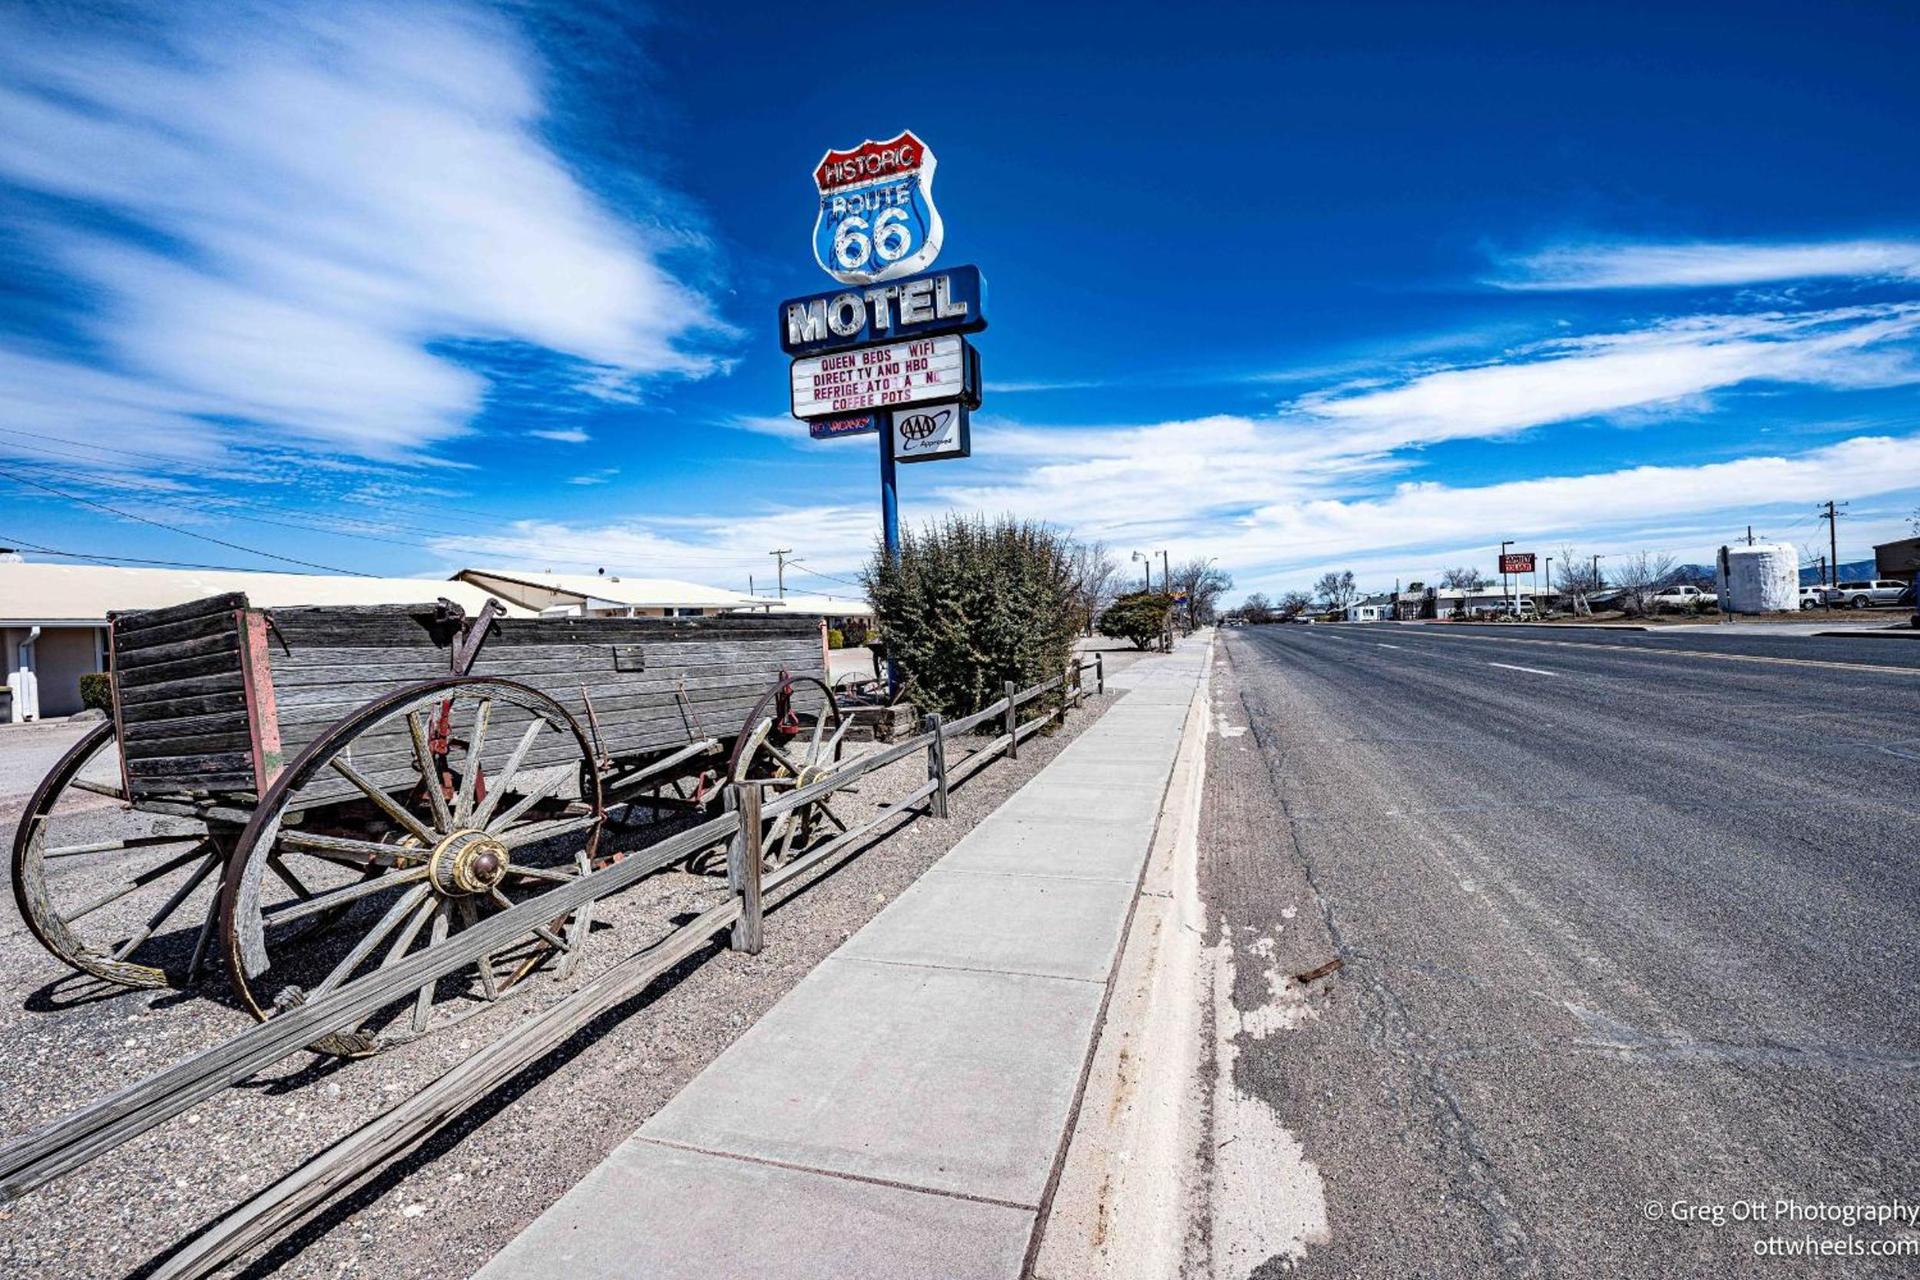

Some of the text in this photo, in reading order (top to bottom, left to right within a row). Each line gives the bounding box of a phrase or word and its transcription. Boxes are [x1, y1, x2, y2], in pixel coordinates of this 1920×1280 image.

[824, 145, 914, 185] HISTORIC
[832, 182, 911, 216] ROUTE
[836, 207, 912, 268] 66
[788, 275, 967, 345] MOTEL
[813, 357, 928, 387] DIRECT TV AND HBO
[821, 341, 935, 372] QUEEN BEDS WIFI
[832, 389, 912, 411] COFFEE POTS
[902, 415, 933, 439] AAA
[920, 438, 953, 448] Approved
